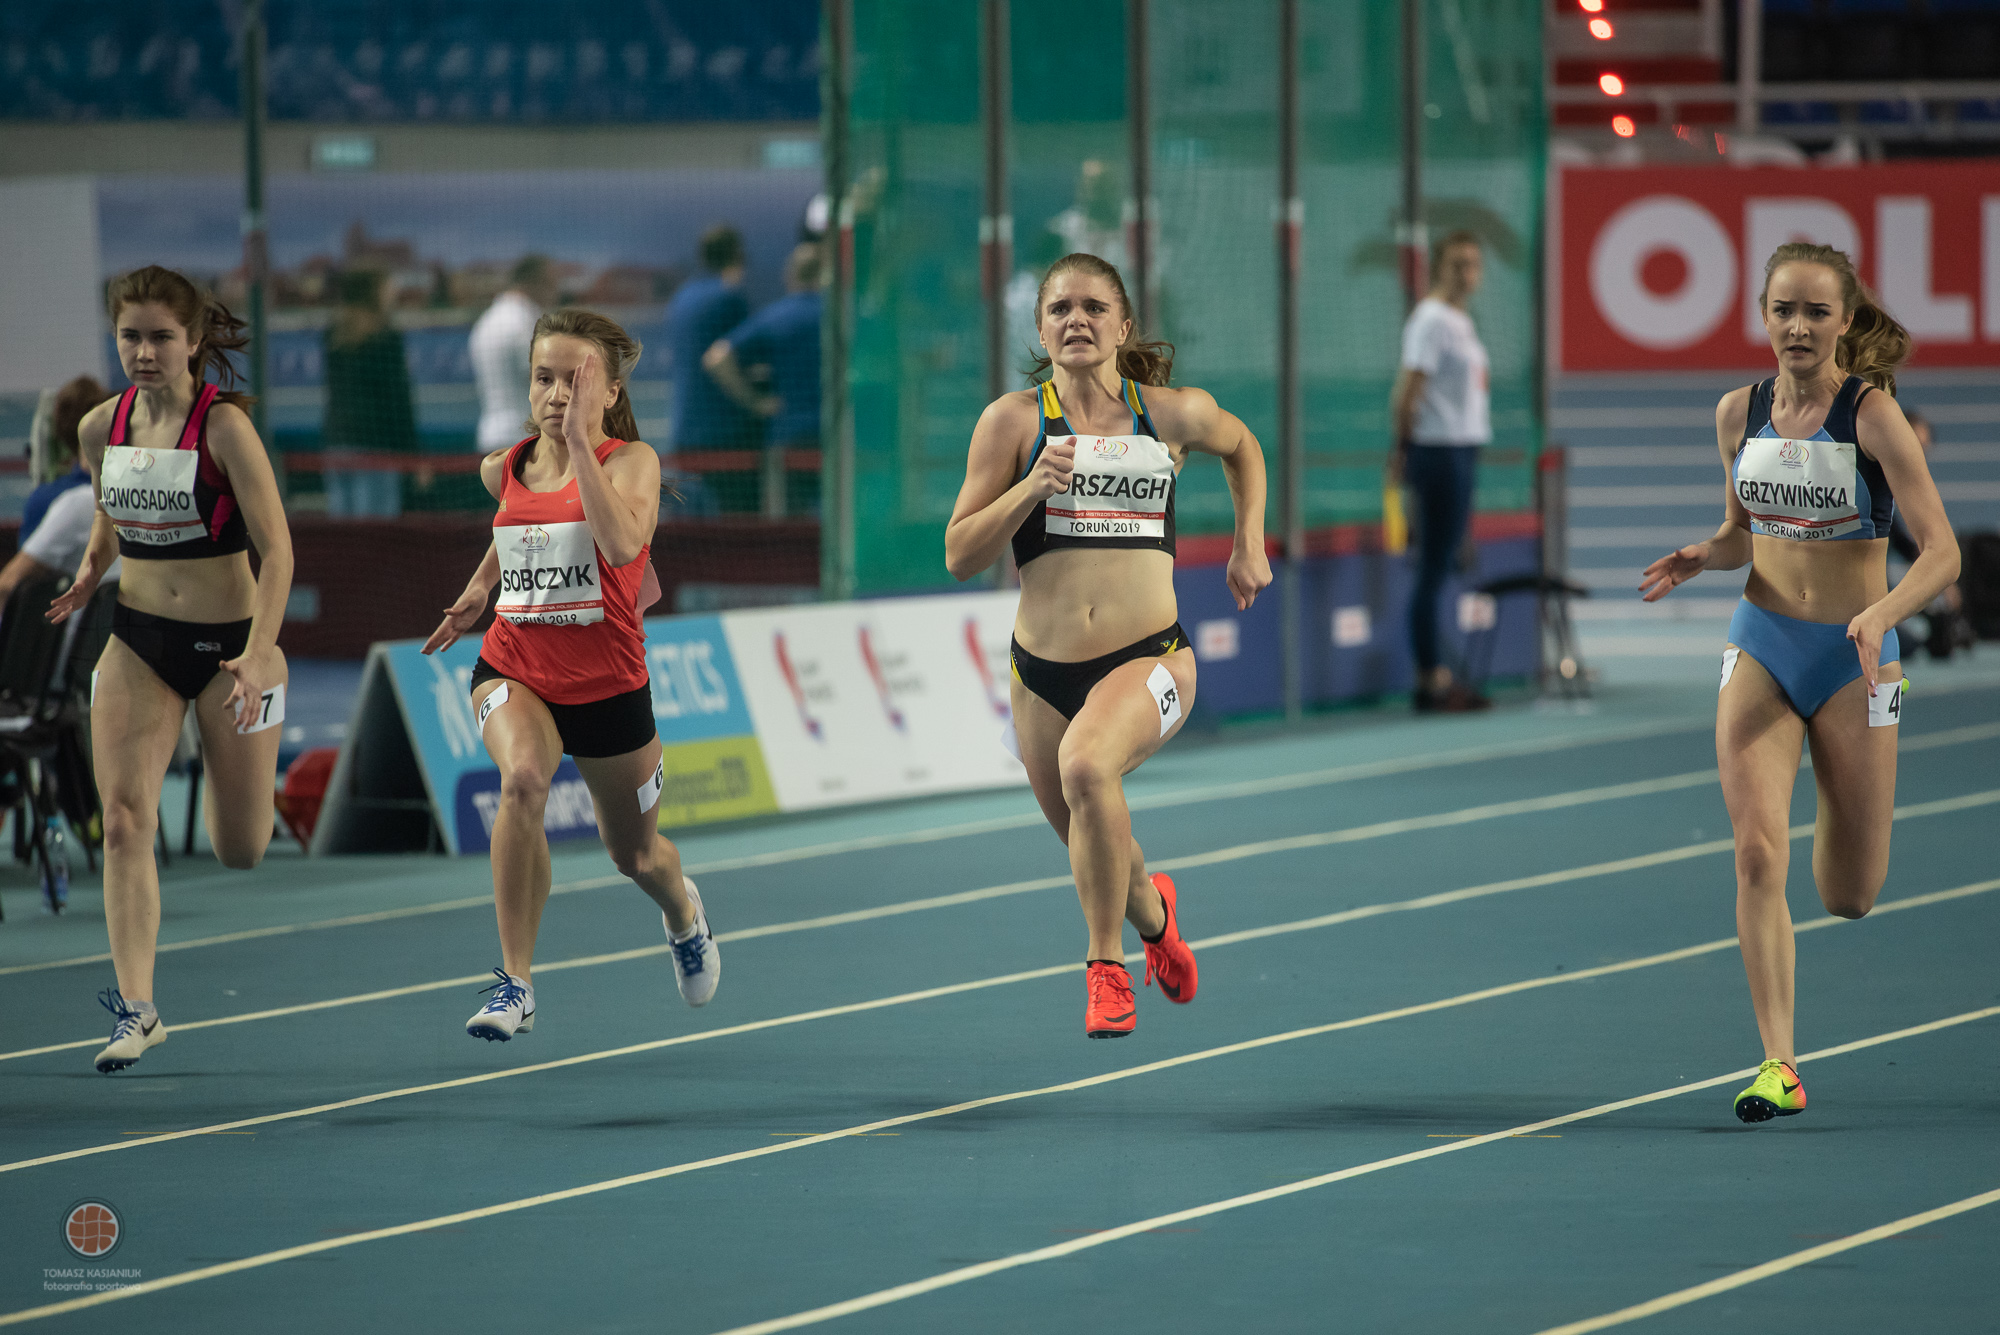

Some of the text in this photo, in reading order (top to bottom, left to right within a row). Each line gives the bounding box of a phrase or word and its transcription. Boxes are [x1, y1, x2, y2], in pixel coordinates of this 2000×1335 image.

[1588, 194, 2000, 351] ORL
[103, 486, 190, 511] NOWOSADKO
[1740, 481, 1848, 509] GRZYWIŃSKA
[123, 528, 180, 543] TORUŃ 2019
[1070, 519, 1140, 533] TORUŃ 2019
[1766, 522, 1834, 539] TORUŃ 2019
[503, 563, 594, 592] SOBCZYK
[549, 613, 577, 624] 2019
[261, 693, 274, 724] 7
[480, 698, 493, 722] 6
[1161, 688, 1176, 715] 5
[655, 763, 664, 790] 6
